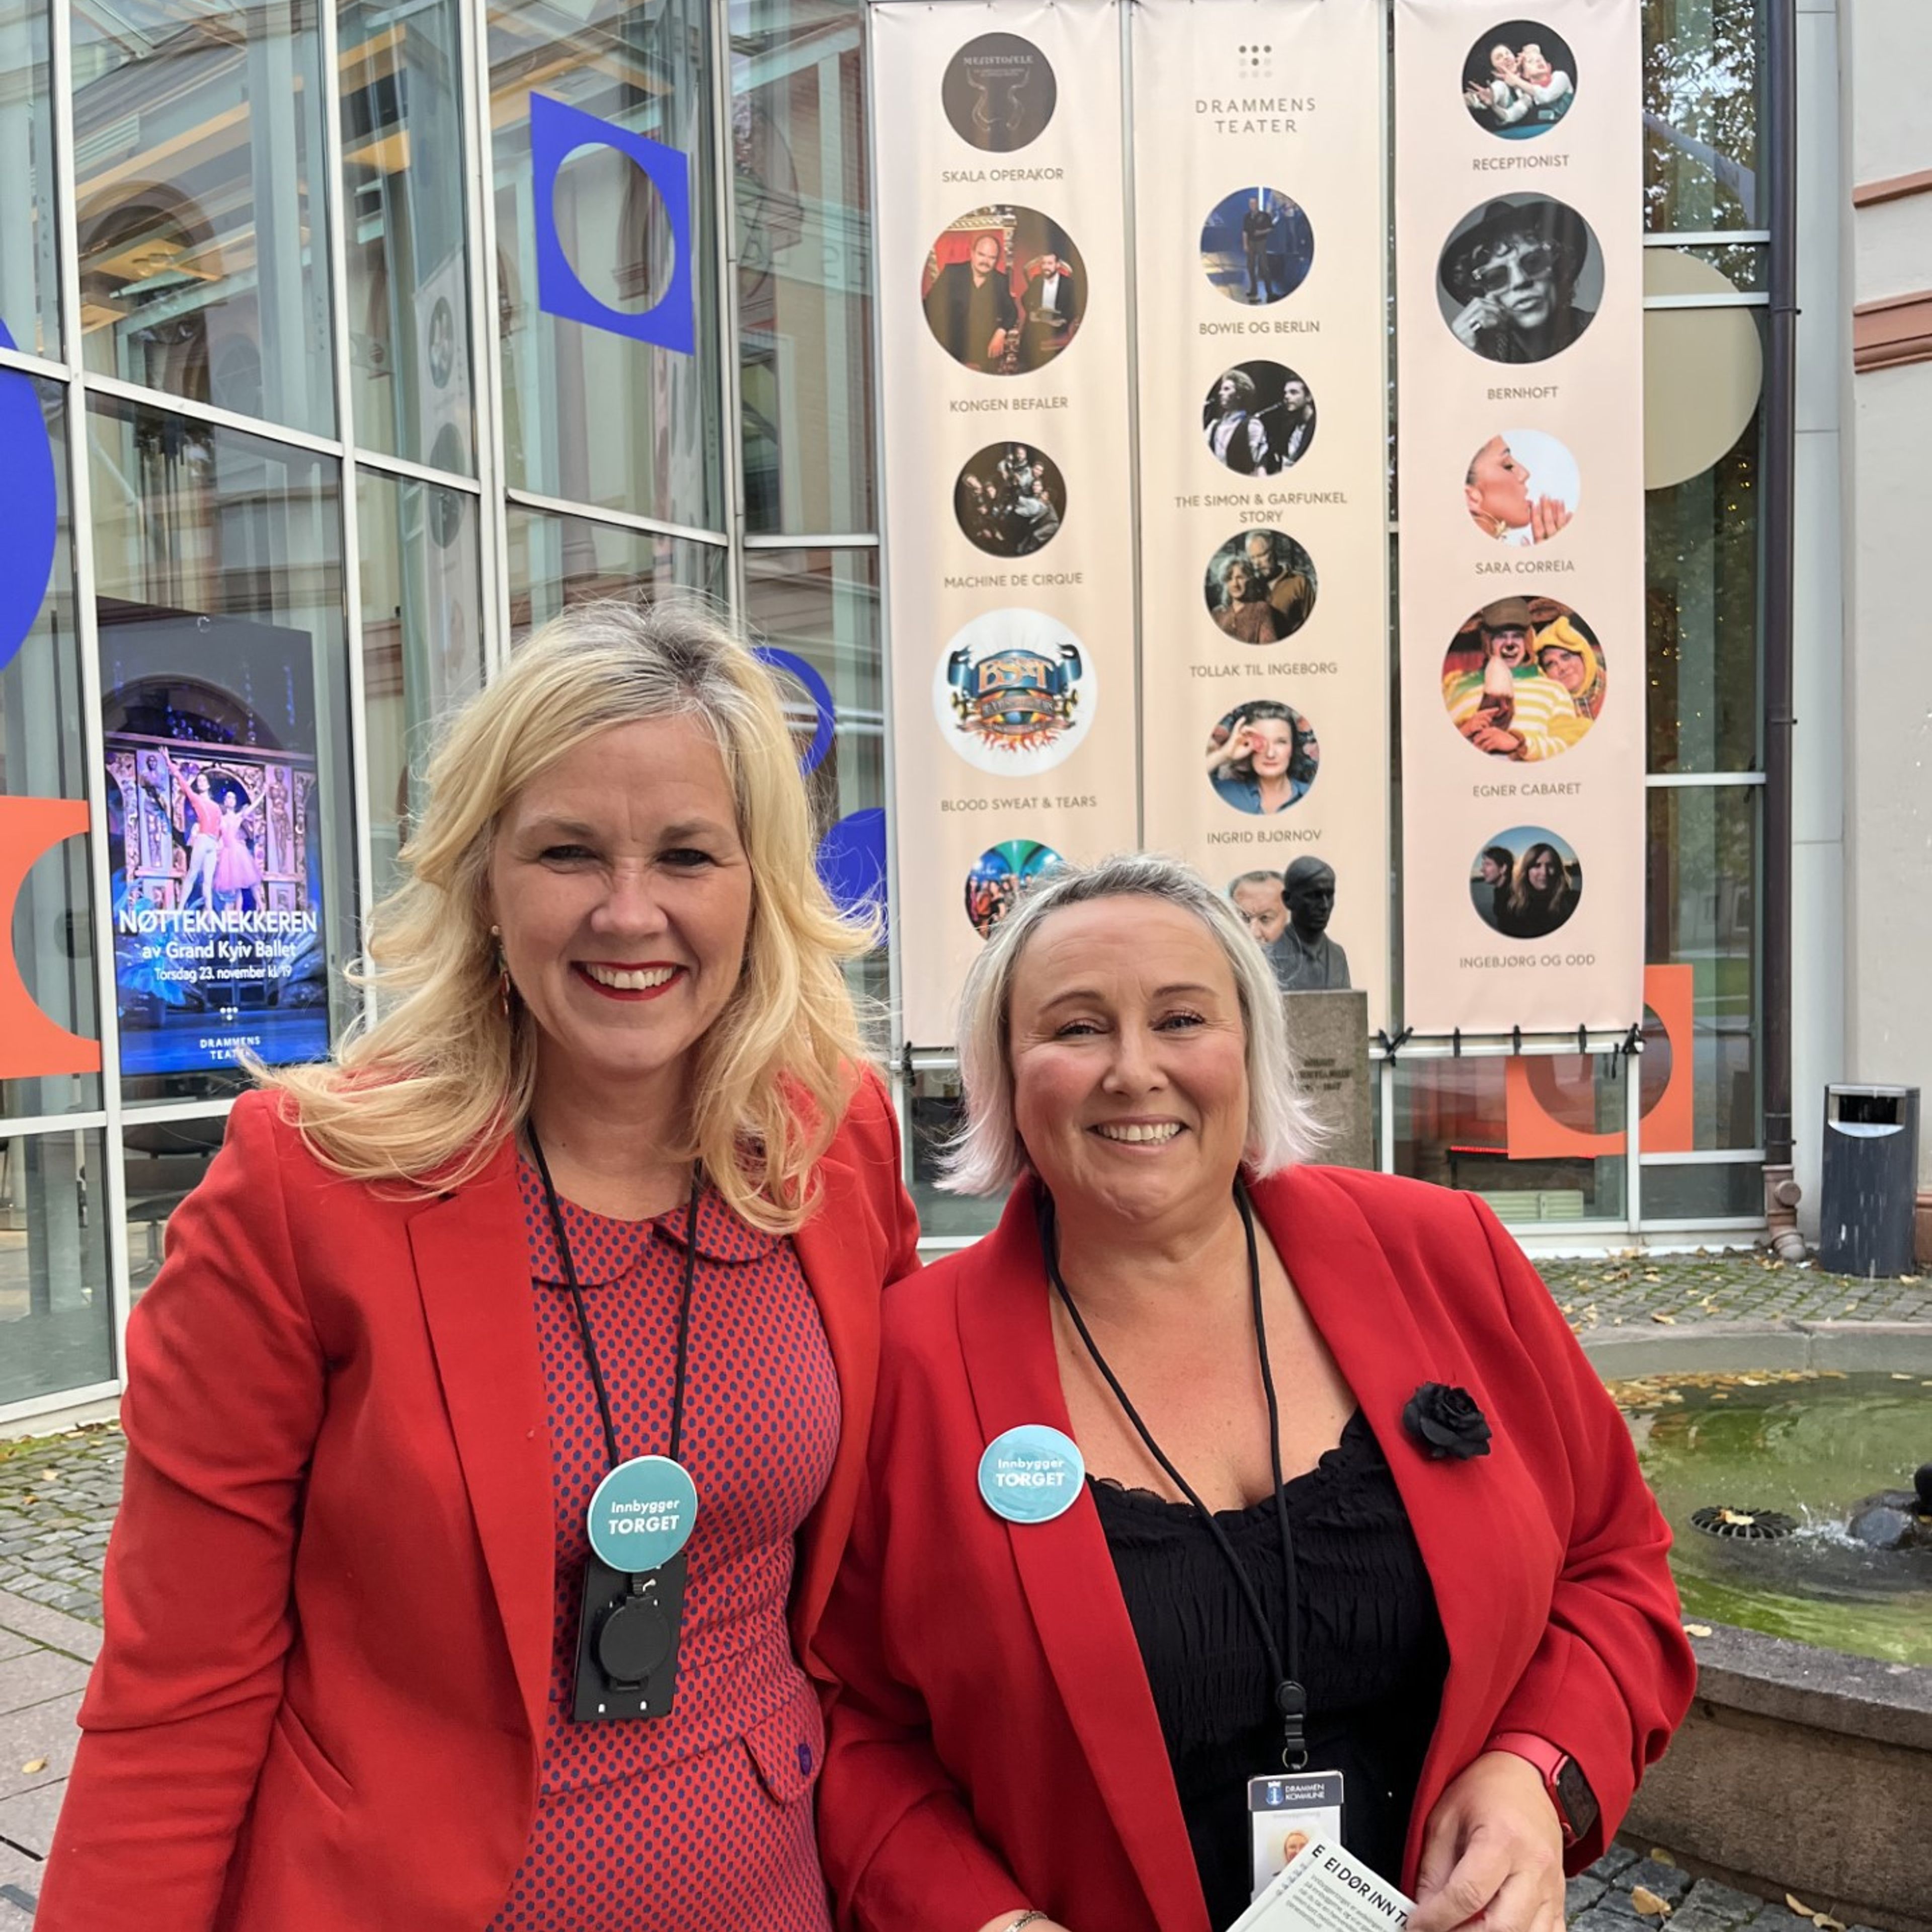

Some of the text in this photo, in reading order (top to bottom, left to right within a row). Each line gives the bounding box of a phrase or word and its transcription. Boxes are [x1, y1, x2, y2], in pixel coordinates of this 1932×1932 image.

[1195, 98, 1316, 114] DRAMMENS
[1215, 119, 1297, 133] TEATER
[1473, 154, 1569, 171] RECEPTIONIST
[942, 168, 1064, 182] SKALA OPERAKOR
[1199, 320, 1320, 335] BOWIE OG BERLIN
[1487, 386, 1558, 400] BERNHOFT
[949, 397, 1069, 413] KONGEN BEFALER
[1175, 492, 1347, 508] THE SIMON & GARFUNKEL
[1239, 510, 1283, 523] STORY
[1476, 559, 1575, 575] SARA CORREIA
[944, 573, 1083, 588] MACHINE DE CIRQUE
[1190, 663, 1338, 678] TOLLAK TIL INGEBORG
[1473, 783, 1581, 797] EGNER CABARET
[941, 796, 1097, 812] BLOOD SWEAT & TEARS
[1208, 830, 1322, 844] INGRID BJØRNOV
[119, 908, 317, 933] NØTTEKNEKKEREN
[142, 939, 297, 963] av Grand Kyiv Ballet
[1460, 954, 1595, 968] INGEBJØRG OG ODD
[153, 967, 197, 983] Torsdag
[199, 966, 215, 980] 23.
[217, 966, 266, 980] november
[200, 1036, 261, 1049] DRAMMENS
[998, 1457, 1065, 1471] Innbygger
[996, 1472, 1065, 1487] TORGET
[611, 1499, 680, 1514] Innbygger
[608, 1515, 680, 1535] TORGET
[1285, 1783, 1325, 1793] DRAMMEN
[1285, 1791, 1325, 1801] KOMMUNE
[1337, 1867, 1371, 1897] DØR
[1367, 1890, 1396, 1916] INN
